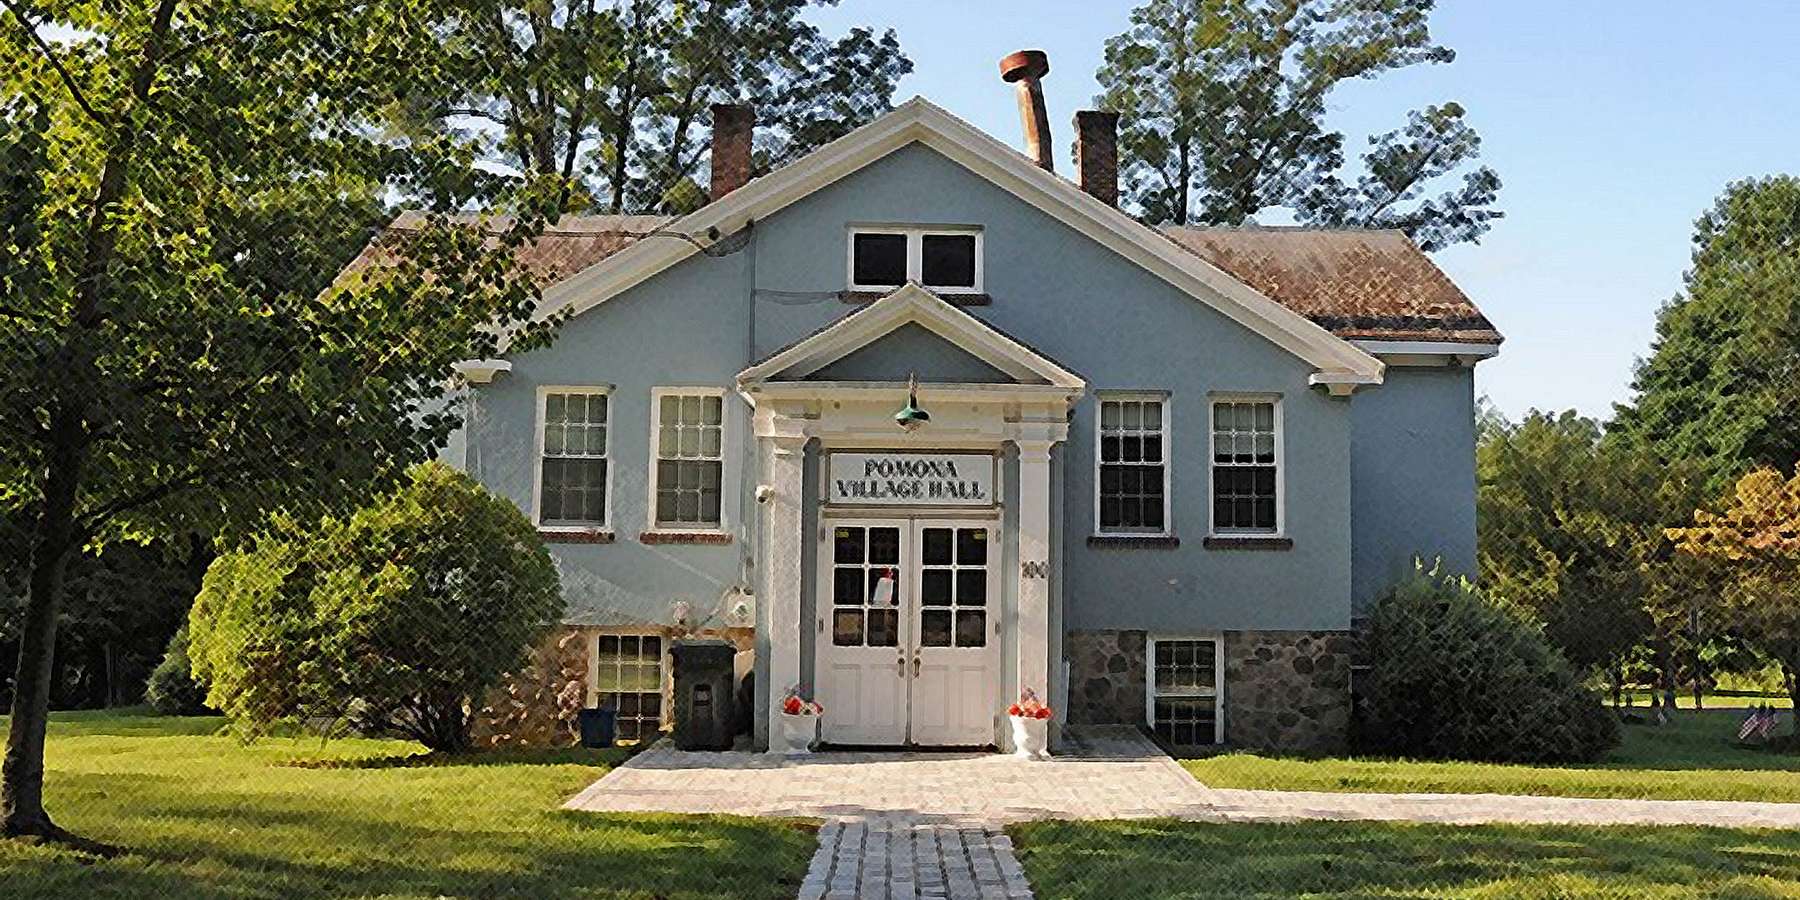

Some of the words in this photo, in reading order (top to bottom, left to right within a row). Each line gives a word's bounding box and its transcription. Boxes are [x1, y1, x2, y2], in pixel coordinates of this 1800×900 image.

[864, 459, 957, 478] POMONA
[836, 480, 924, 498] VILLAGE
[928, 481, 985, 499] HALL
[1021, 561, 1049, 579] 100
